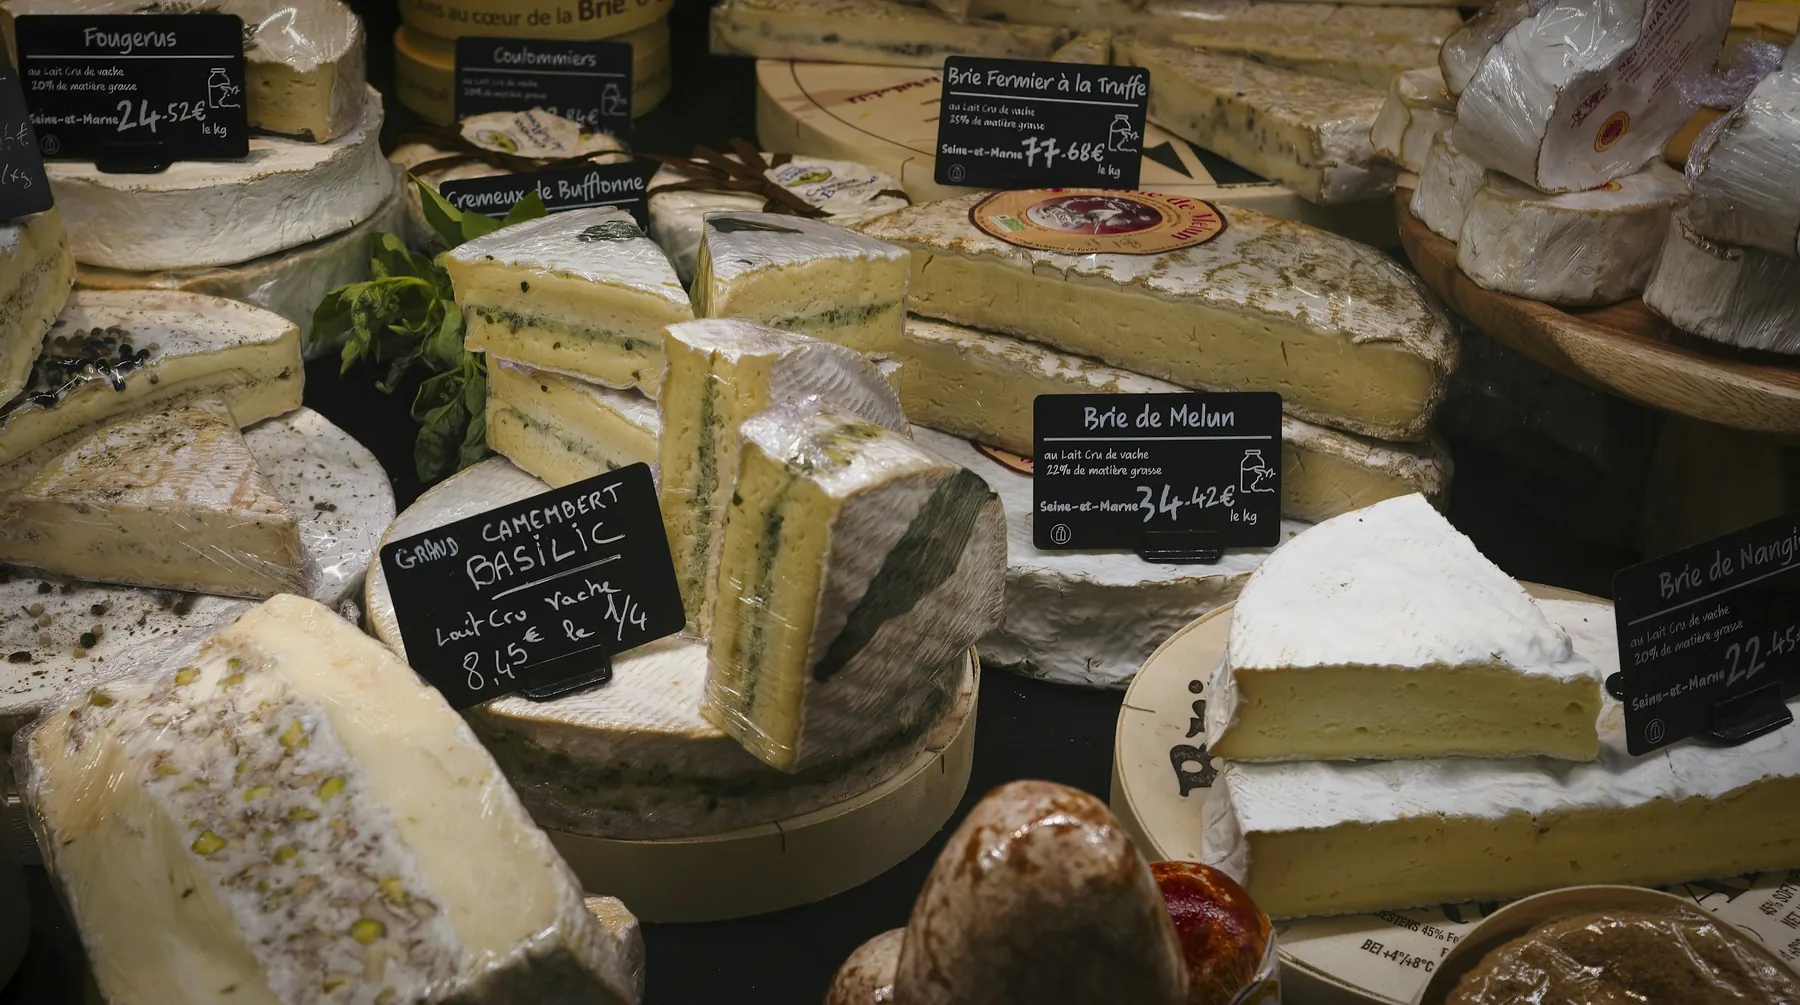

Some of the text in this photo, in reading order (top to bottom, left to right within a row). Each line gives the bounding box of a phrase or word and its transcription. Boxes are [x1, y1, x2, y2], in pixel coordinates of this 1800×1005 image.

[472, 11, 520, 27] cœur
[527, 9, 552, 27] de
[556, 6, 573, 25] la
[84, 27, 177, 54] Fougerus
[494, 46, 597, 67] Coulommiers
[28, 65, 125, 76] au Lait Cru de vache
[56, 80, 67, 91] de
[70, 81, 106, 91] matière
[108, 83, 138, 94] grasse
[948, 66, 1147, 100] Brie Fermier à la Truffe
[29, 99, 207, 133] Seine-et-Marne 24.52€
[949, 102, 1035, 116] au Lait Cru de vache
[201, 124, 228, 138] le kg
[971, 115, 982, 126] de
[984, 116, 1017, 129] matière
[1018, 120, 1045, 131] grasse
[941, 136, 1105, 168] Seine-et-Marne 77.68€
[1097, 164, 1121, 179] le kg
[558, 171, 645, 201] Bufflonne
[1084, 403, 1235, 430] Brie de Melun
[1044, 449, 1149, 460] au Lait Cru de vache
[1046, 464, 1162, 479] 22% de matière grasse
[1040, 483, 1235, 523] Seine-et-Marne 34.42€
[395, 482, 623, 569] GRAND CAMEMBERT
[1230, 509, 1257, 525] le kg
[1659, 526, 1800, 600] Brie de Nangi
[436, 610, 484, 647] Lait
[562, 619, 595, 642] le
[603, 593, 648, 641] 1/4
[1630, 604, 1730, 649] au Lait Cru de vache
[1661, 642, 1672, 657] de
[1675, 629, 1712, 652] matière
[1713, 619, 1744, 642] grasse
[1632, 669, 1726, 711] Seine-et-Marne
[1758, 898, 1784, 916] 45%
[1421, 924, 1444, 941] 45%
[1360, 938, 1383, 960] BEI
